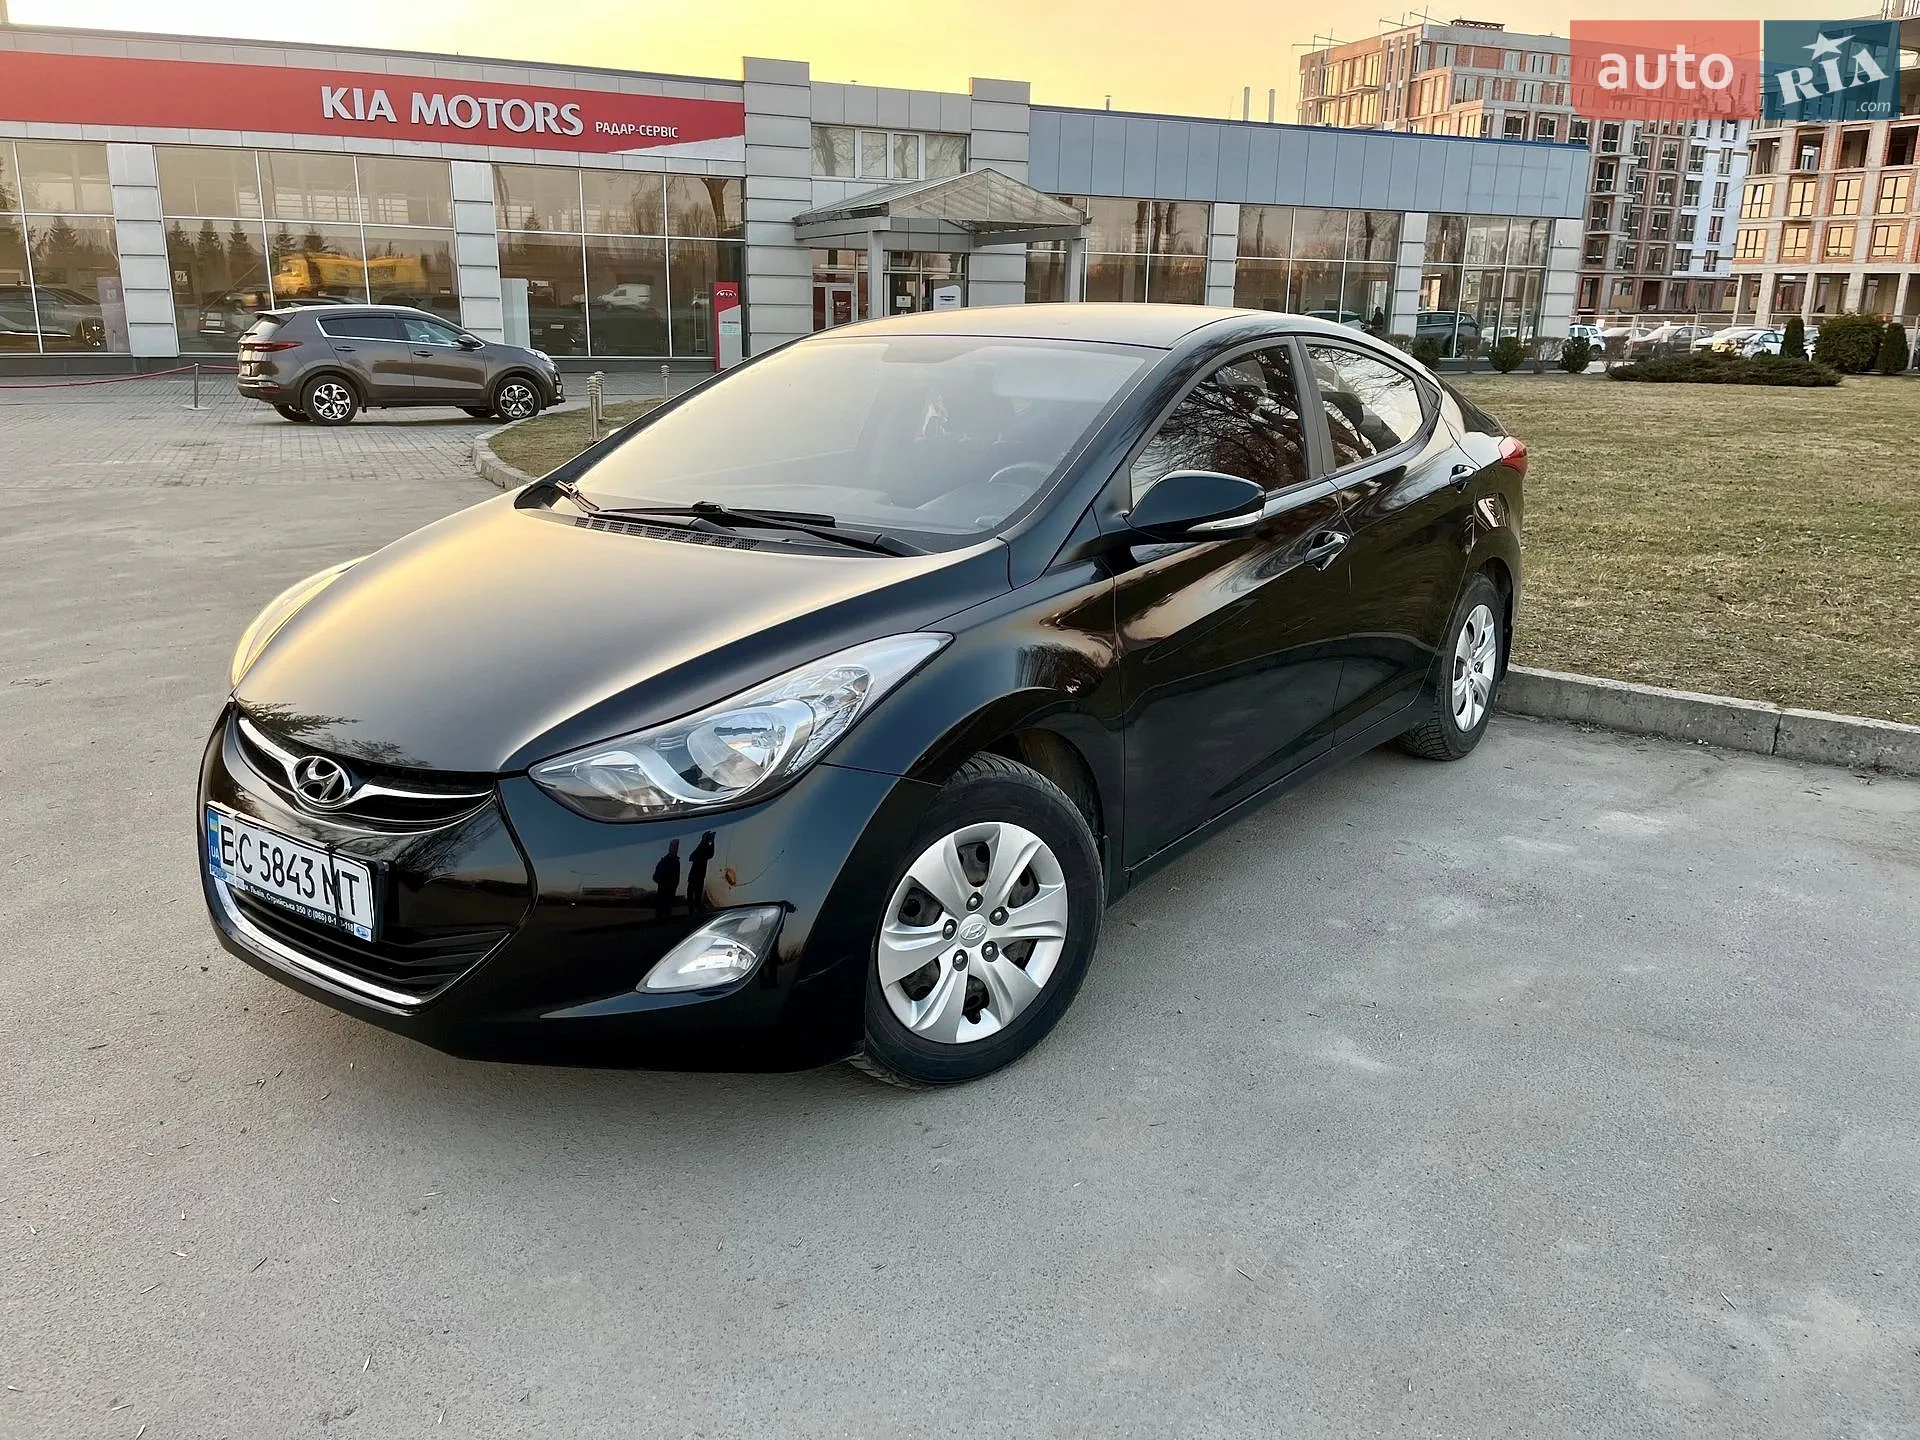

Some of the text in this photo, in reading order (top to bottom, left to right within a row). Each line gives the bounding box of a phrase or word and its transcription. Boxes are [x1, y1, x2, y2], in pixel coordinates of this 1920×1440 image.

[320, 86, 585, 137] KIA MOTORS
[595, 121, 679, 139] РАДАР-СЕРВІС
[259, 840, 316, 899] 5843
